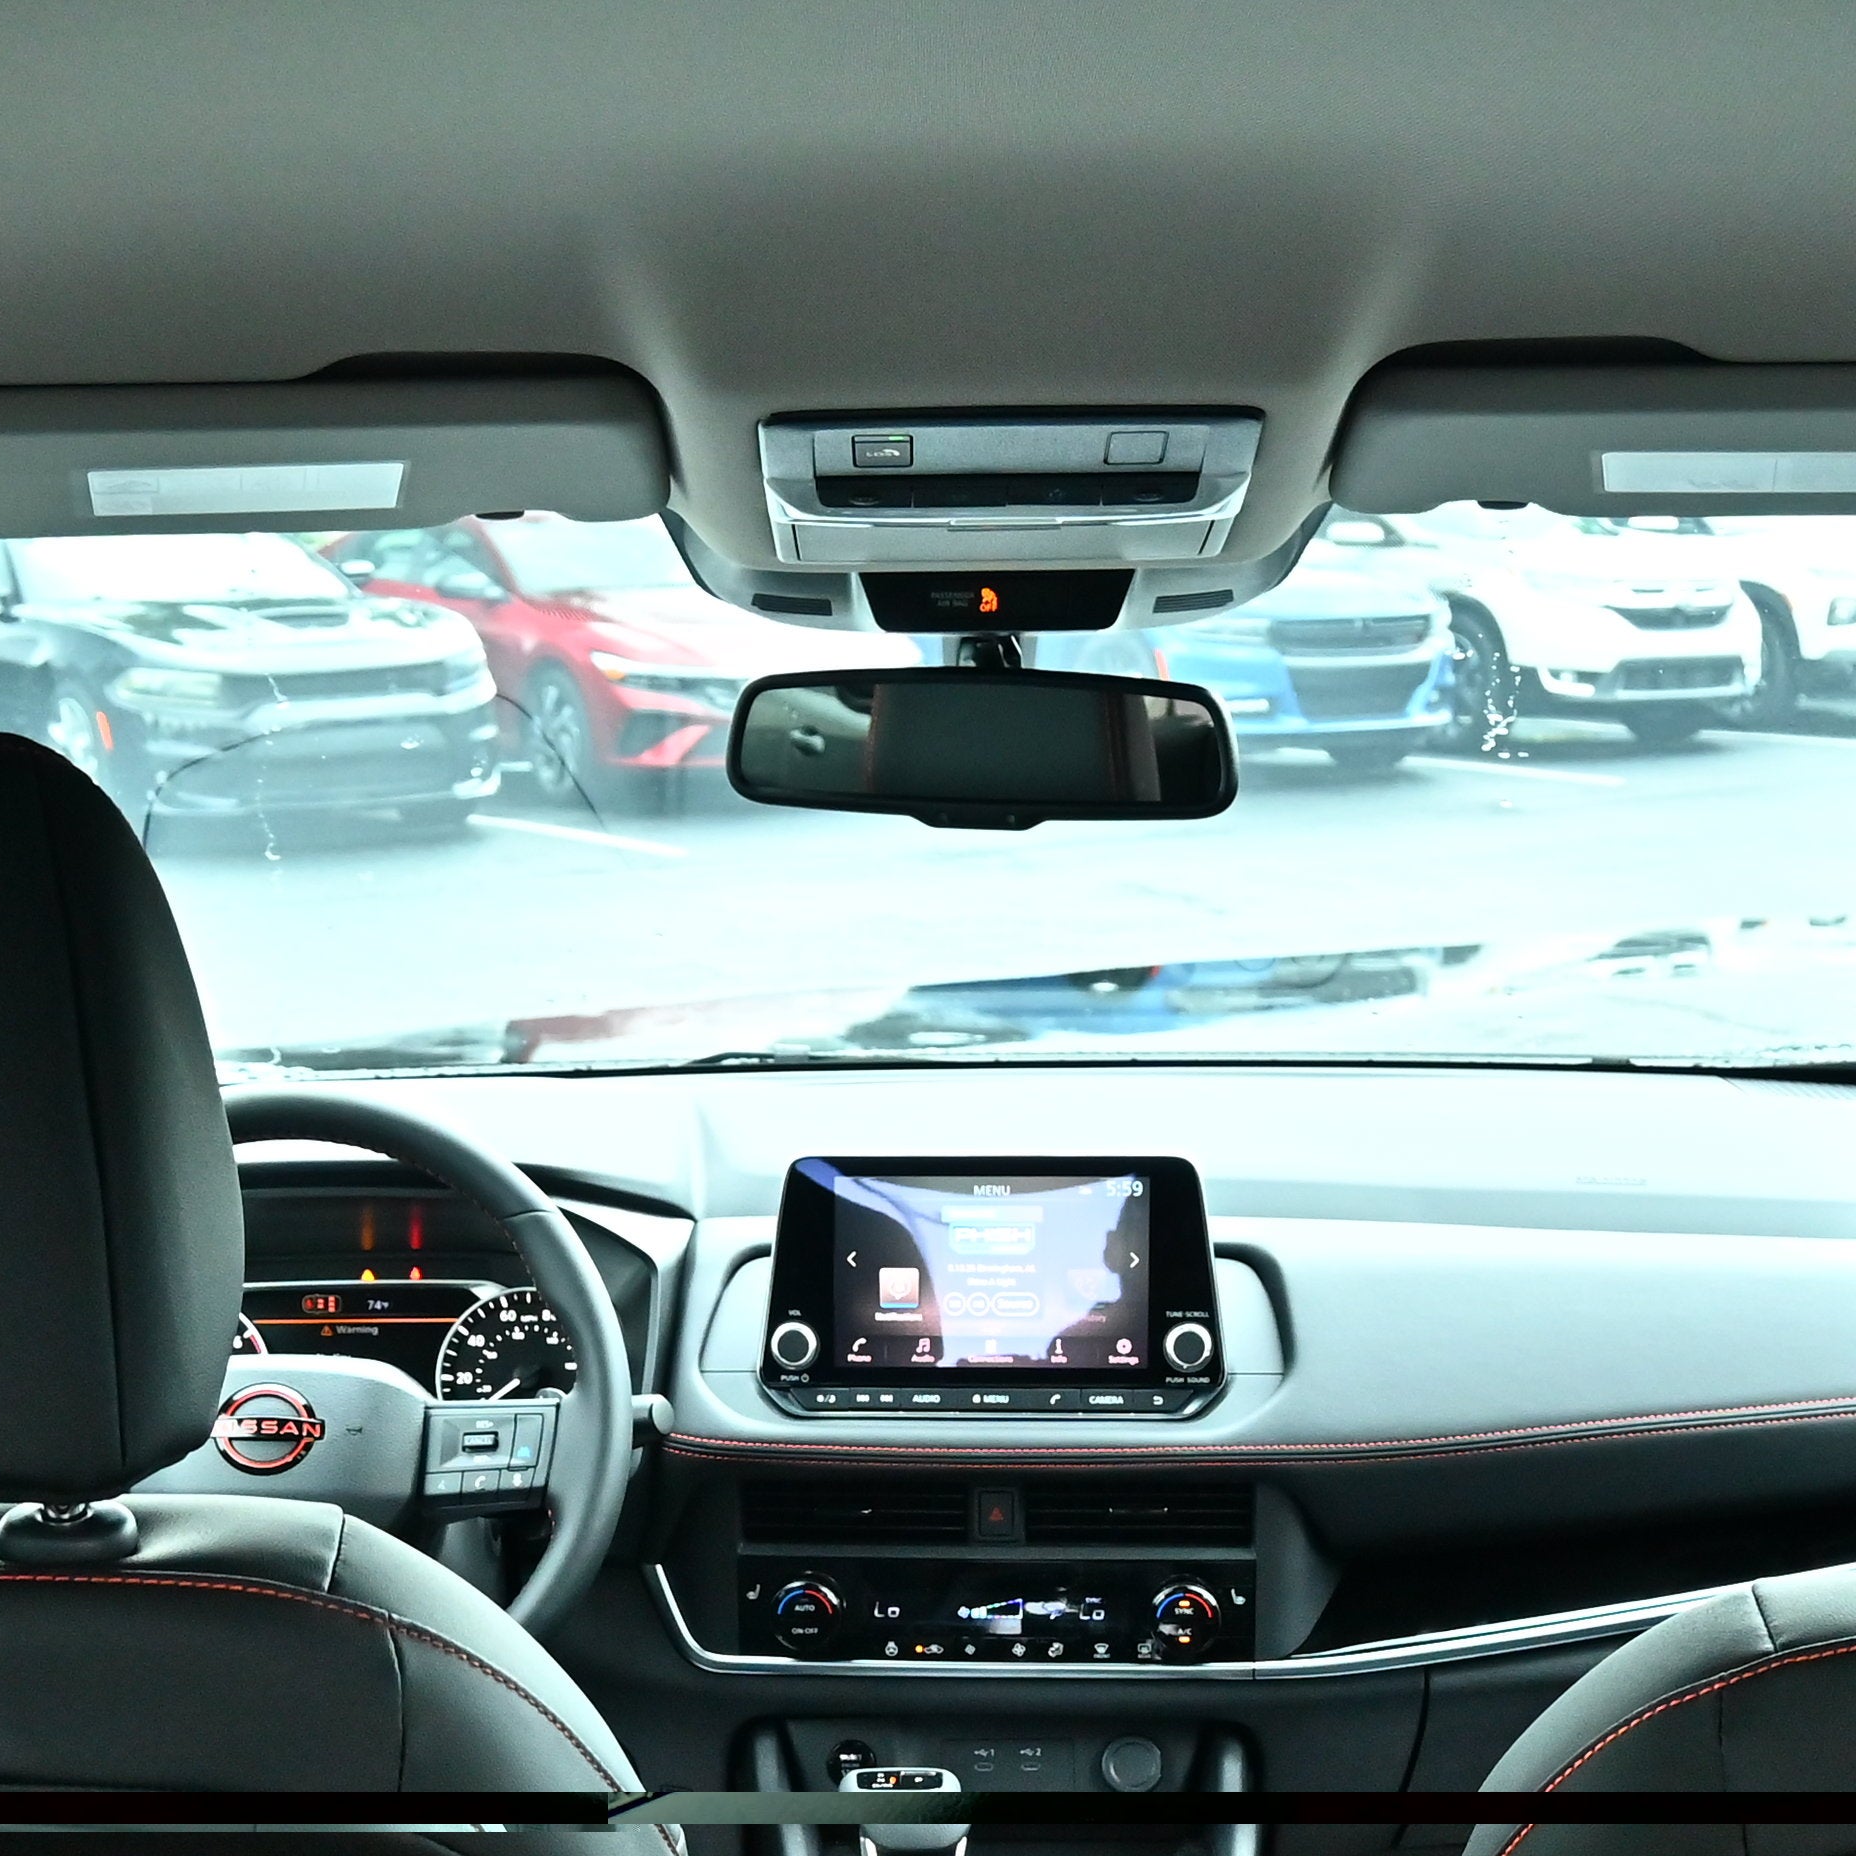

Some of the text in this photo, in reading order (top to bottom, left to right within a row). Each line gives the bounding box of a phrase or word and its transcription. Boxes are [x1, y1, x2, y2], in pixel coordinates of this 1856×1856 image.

[973, 1184, 1011, 1197] MENU
[1105, 1180, 1144, 1198] 5:59
[499, 1309, 517, 1322] 60
[335, 1325, 380, 1336] Warning
[467, 1334, 485, 1347] 40
[456, 1371, 473, 1385] 20
[912, 1393, 941, 1404] AUDIO
[983, 1393, 1009, 1404] MENU
[1088, 1395, 1124, 1405] CAMERA
[220, 1419, 321, 1438] SSAN
[794, 1604, 815, 1612] AUTO
[1174, 1608, 1195, 1616] SYNC
[1177, 1628, 1193, 1636] A/C
